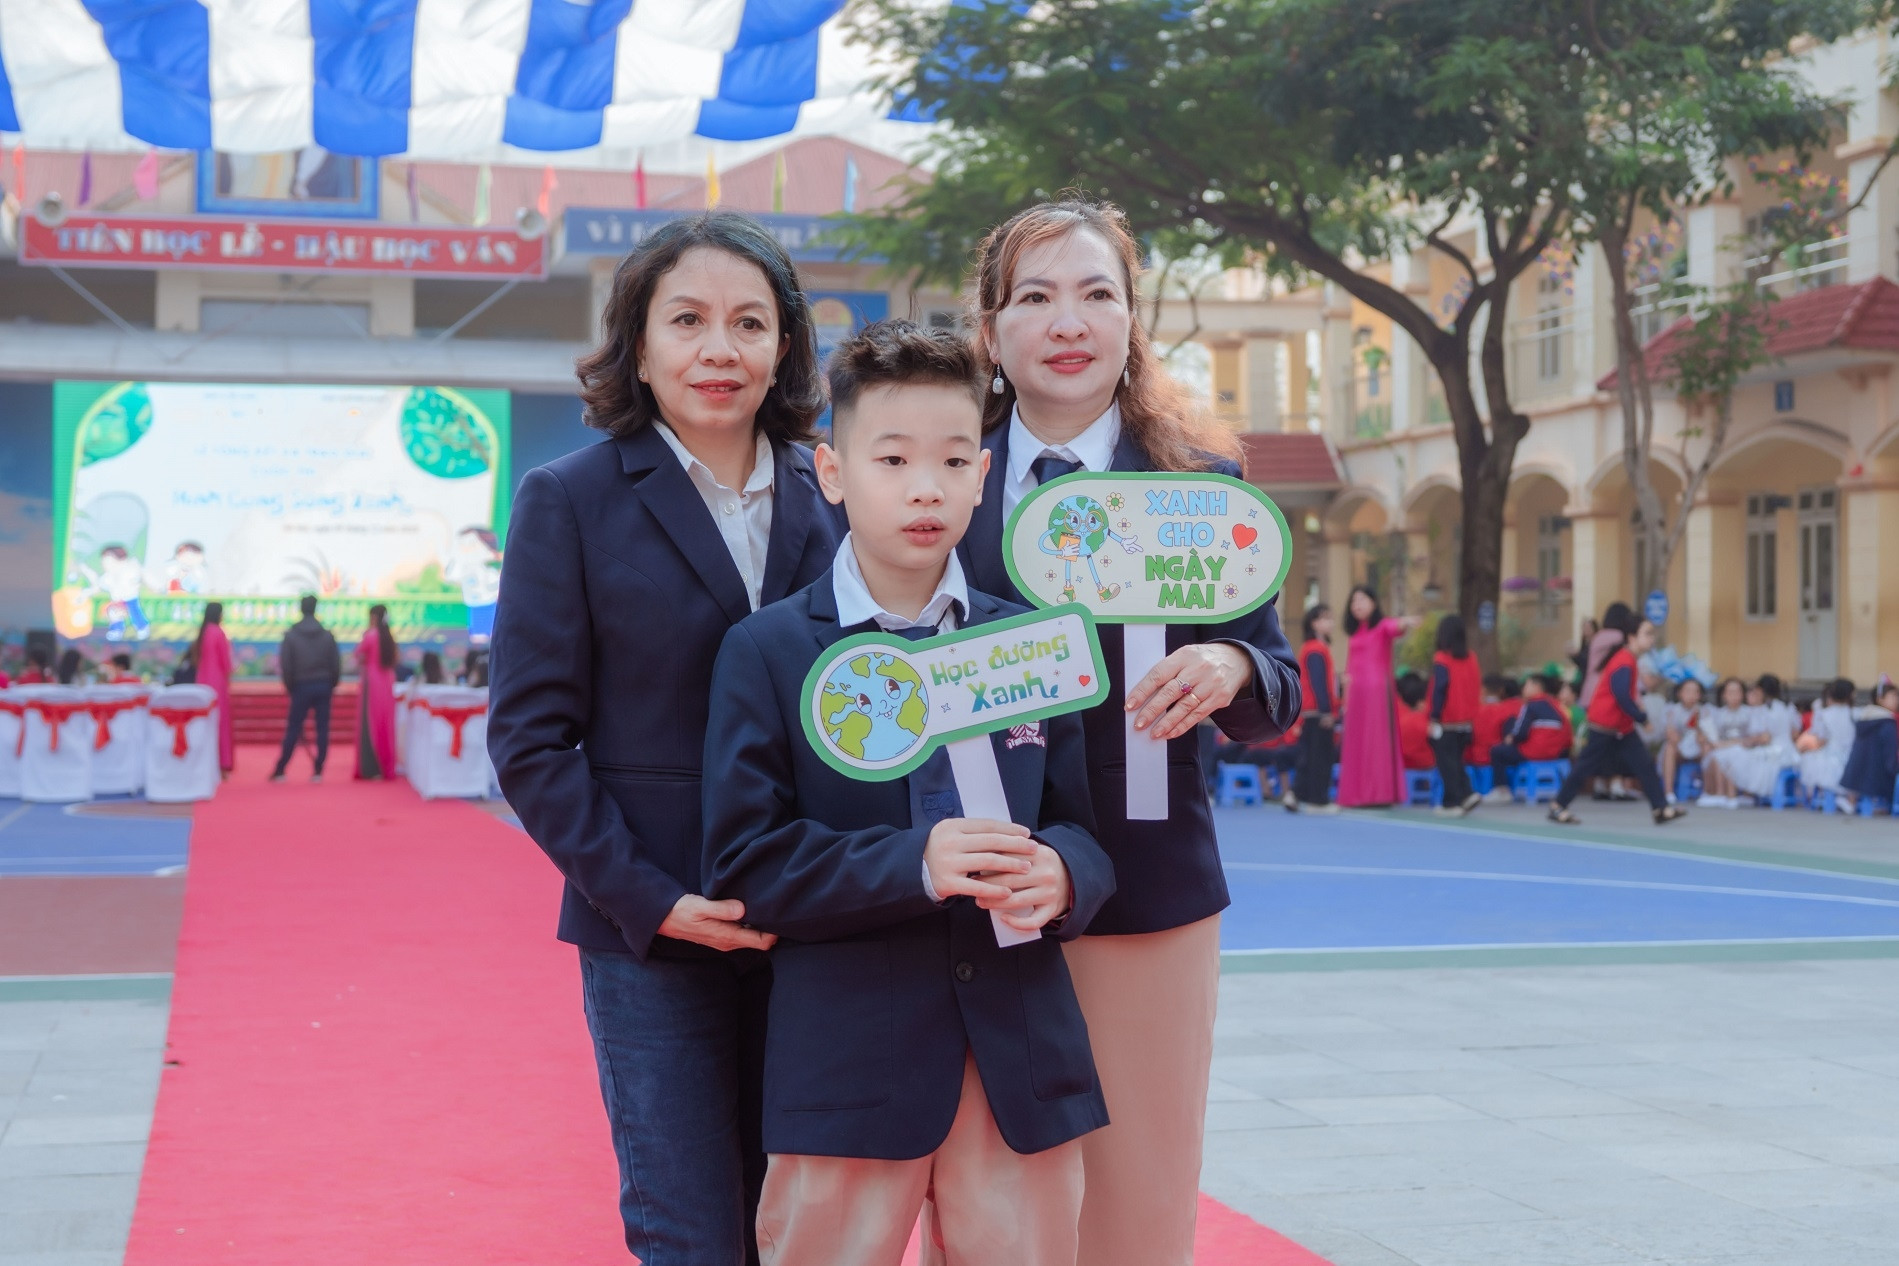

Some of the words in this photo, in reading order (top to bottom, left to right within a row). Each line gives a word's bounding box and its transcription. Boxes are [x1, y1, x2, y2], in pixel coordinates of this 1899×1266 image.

[1145, 489, 1228, 516] XANH
[1158, 522, 1215, 547] CHO
[1145, 548, 1228, 581] NGÀY
[1158, 583, 1215, 609] MAI
[929, 660, 979, 686] Học
[988, 633, 1071, 670] đường
[966, 670, 1059, 713] Xanh
